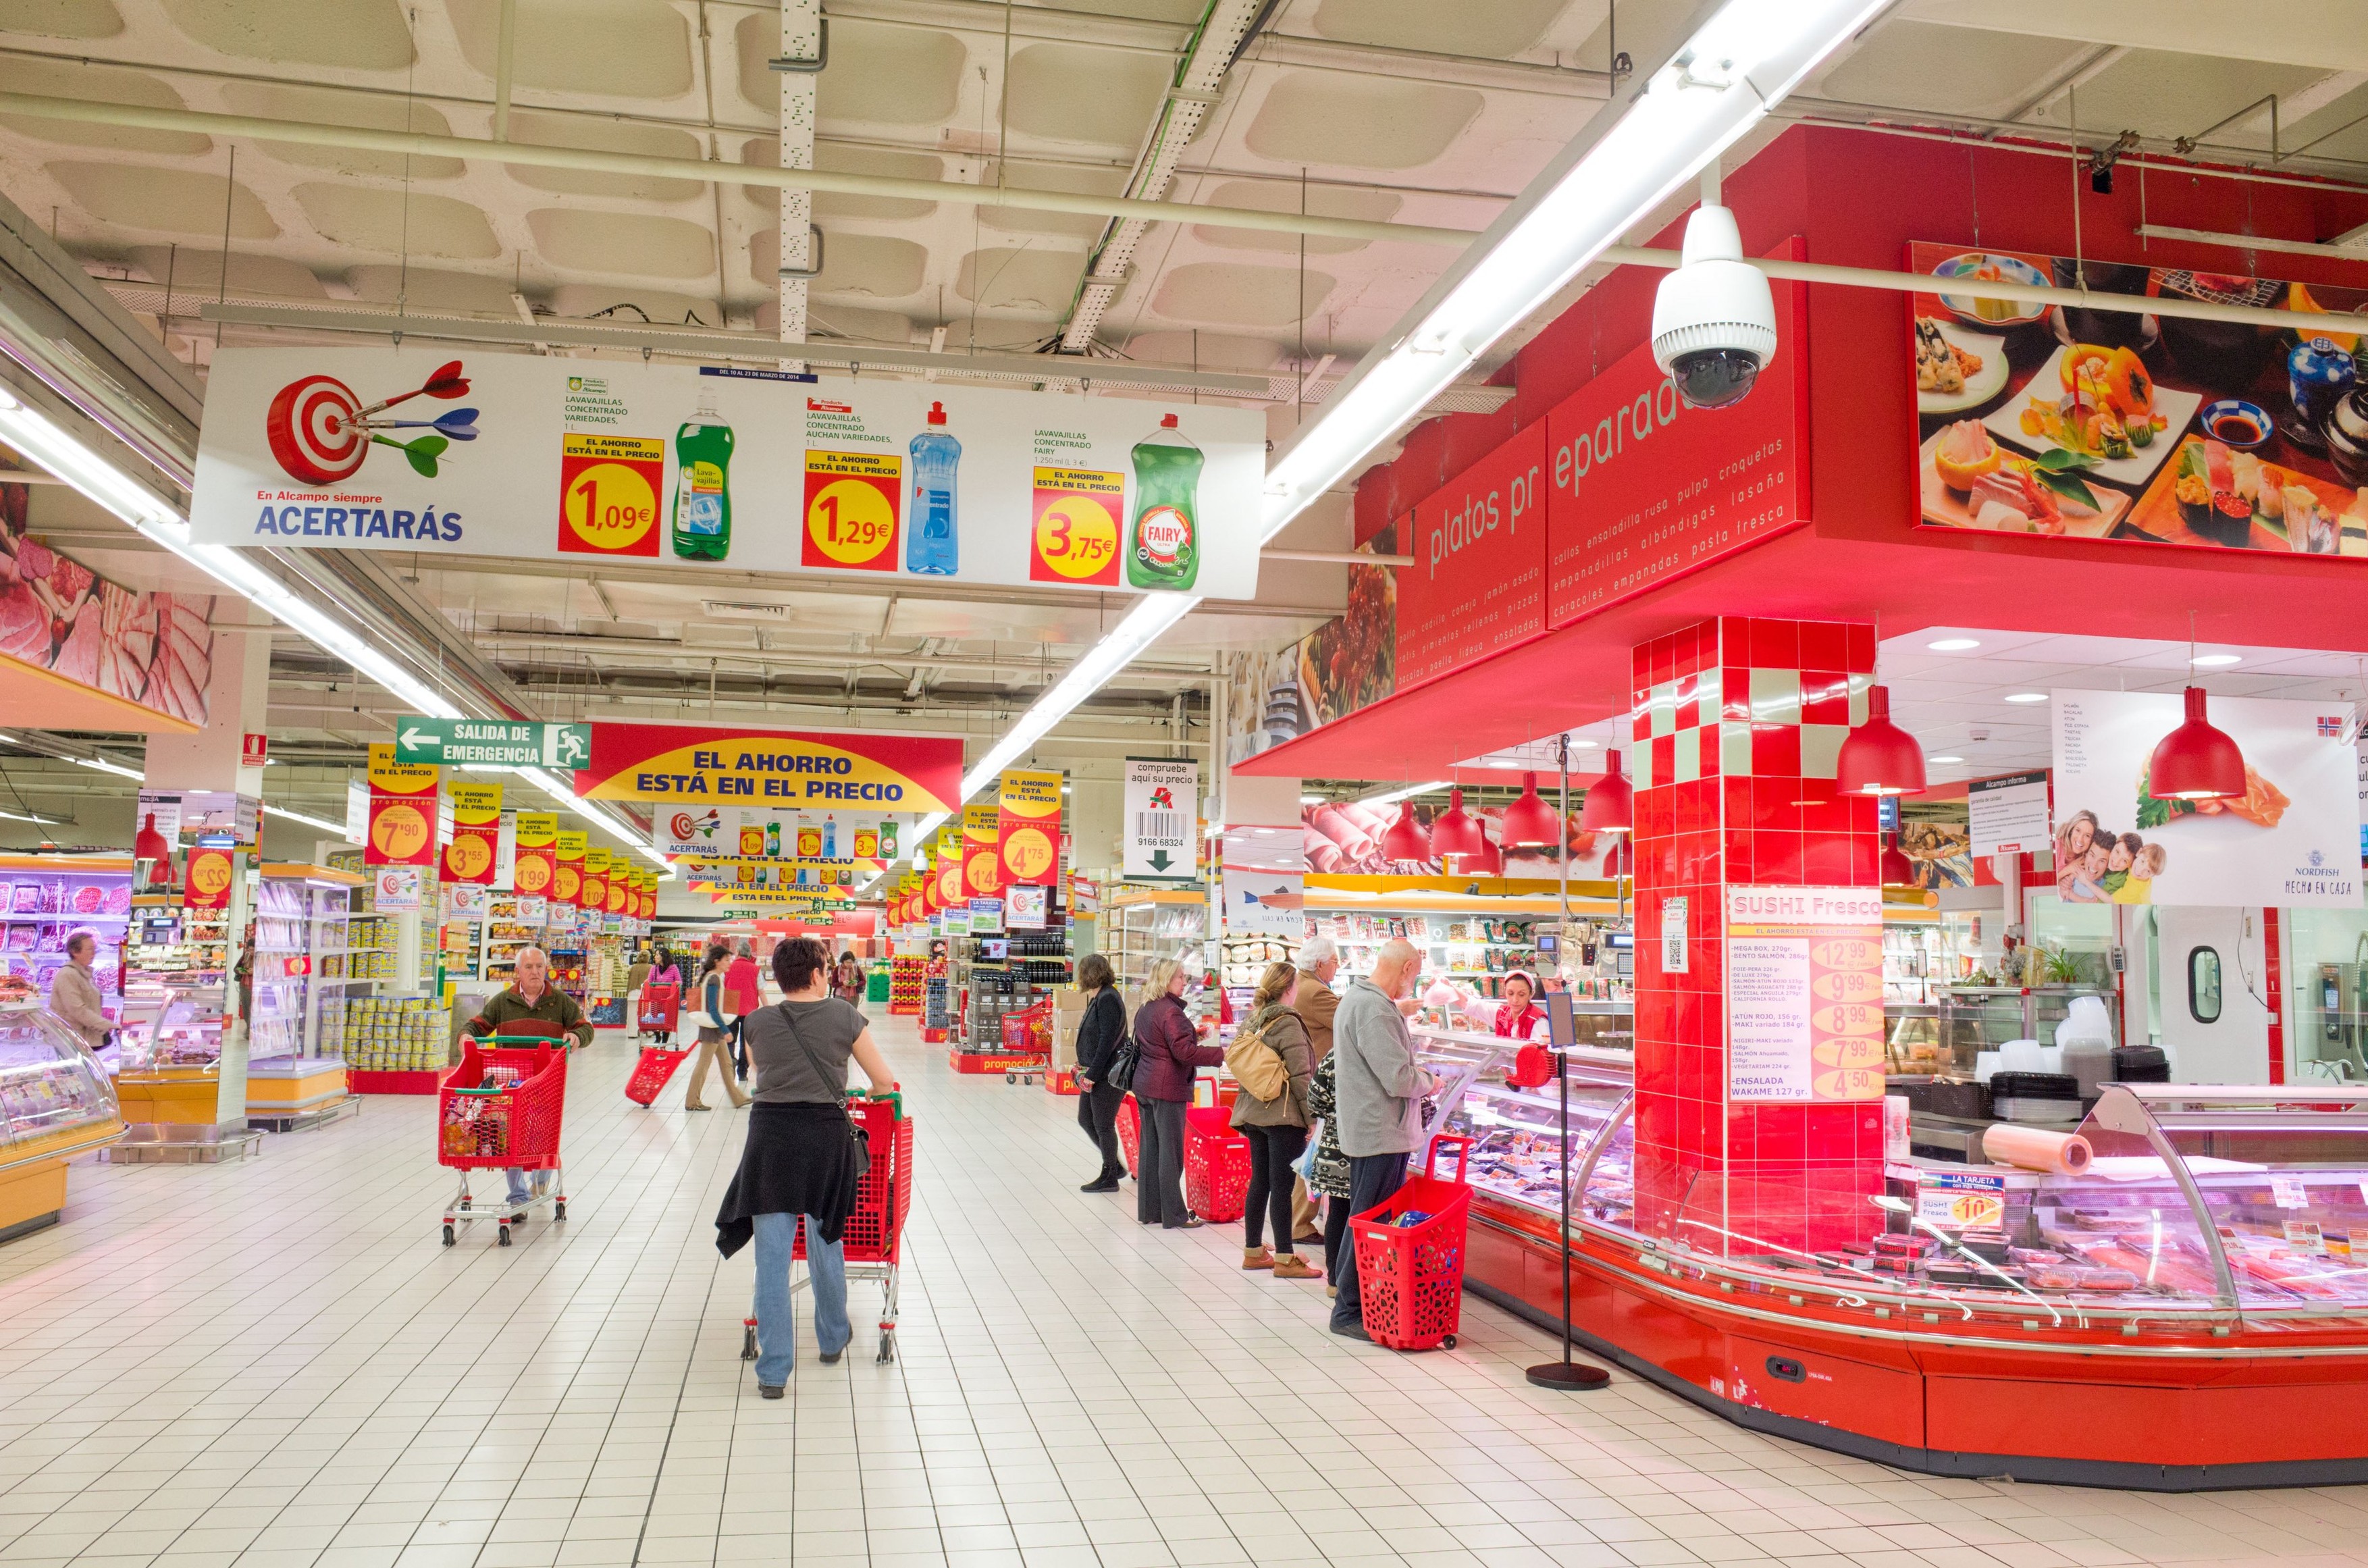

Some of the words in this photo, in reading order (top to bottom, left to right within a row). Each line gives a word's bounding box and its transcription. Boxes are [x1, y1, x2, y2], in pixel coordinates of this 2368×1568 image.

[565, 396, 623, 406] LAVAVAJILLAS
[565, 405, 628, 415] CONCENTRADO
[564, 414, 619, 425] VARIEDADES,
[806, 413, 861, 423] LAVAVAJILLAS
[806, 422, 865, 432] CONCENTRADO
[806, 431, 840, 439] AUCHAN
[841, 433, 893, 444] VARIEDADES,
[1034, 429, 1086, 440] LAVAVAJILLAS
[601, 440, 641, 448] AHORRO
[1034, 439, 1092, 449] CONCENTRADO
[567, 446, 592, 454] ESTÁ
[625, 451, 660, 459] PRECIO
[1034, 447, 1055, 455] FAIRY
[841, 456, 880, 465] AHORRO
[1034, 456, 1053, 465] 1.250
[808, 463, 833, 471] ESTÁ
[864, 467, 897, 475] PRECIO
[1067, 473, 1104, 481] AHORRO
[1036, 479, 1059, 487] ESTÁ
[1089, 484, 1121, 492] PRECIO
[257, 490, 272, 500] En
[277, 492, 329, 502] Alcampo
[333, 494, 383, 504] siempre
[1554, 544, 1580, 566] callos
[1587, 513, 1640, 548] ensaladilla
[1645, 498, 1668, 519] rusa
[1677, 477, 1708, 506] pulpo
[1718, 438, 1783, 481] croquetas
[576, 480, 650, 531] 1,09€
[254, 504, 463, 542] ACERTARÁS
[818, 496, 889, 546] 1,29€
[1046, 512, 1113, 560] 3,75€
[1148, 526, 1181, 542] FAIRY
[1430, 490, 1500, 581] platos
[1554, 548, 1629, 592] empanadillas
[1641, 504, 1716, 550] albóndigas
[1731, 470, 1784, 506] lasaña
[1554, 587, 1604, 619] caracoles
[1614, 552, 1679, 591] empanadas
[1691, 529, 1729, 559] pasta
[1737, 504, 1784, 535] fresca
[1421, 613, 1446, 633] codillo
[1452, 598, 1477, 618] conejo
[1483, 583, 1508, 605] jamón
[1512, 567, 1539, 587] asado
[1422, 631, 1459, 656] pimientos
[1463, 610, 1499, 634] rellenos
[1508, 592, 1539, 617] pizzas
[1494, 617, 1539, 644] ensaladas
[454, 724, 507, 741] SALIDA
[511, 727, 531, 741] DE
[443, 745, 540, 763] EMERGENCIA
[693, 751, 727, 769] EL
[735, 754, 852, 775] AHORRO
[1137, 764, 1187, 774] compruebe
[1021, 780, 1054, 788] AHORRO
[1131, 773, 1151, 784] aquí
[1165, 776, 1192, 785] precio
[1986, 779, 2007, 789] Alcampo
[2007, 776, 2027, 784] informa
[637, 770, 708, 793] ESTÁ
[718, 777, 755, 795] EN
[764, 779, 796, 797] EL
[806, 781, 903, 802] PRECIO
[1021, 786, 1041, 794] ESTÁ
[1003, 821, 1056, 830] promoción
[1138, 837, 1157, 846] 9166
[1159, 838, 1184, 847] 68324
[669, 844, 718, 854] ACERTARÁS
[2295, 867, 2340, 877] NORDFISH
[749, 883, 765, 891] EN
[768, 883, 783, 891] EL
[787, 884, 829, 893] PRECIO
[2285, 881, 2312, 894] HECHO
[2315, 881, 2325, 895] EN
[2330, 882, 2351, 895] CASA
[1734, 896, 1805, 915] SUSHI
[1813, 897, 1882, 916] Fresco
[1795, 1089, 1808, 1097] gr.
[1964, 1176, 1995, 1184] TARJETA
